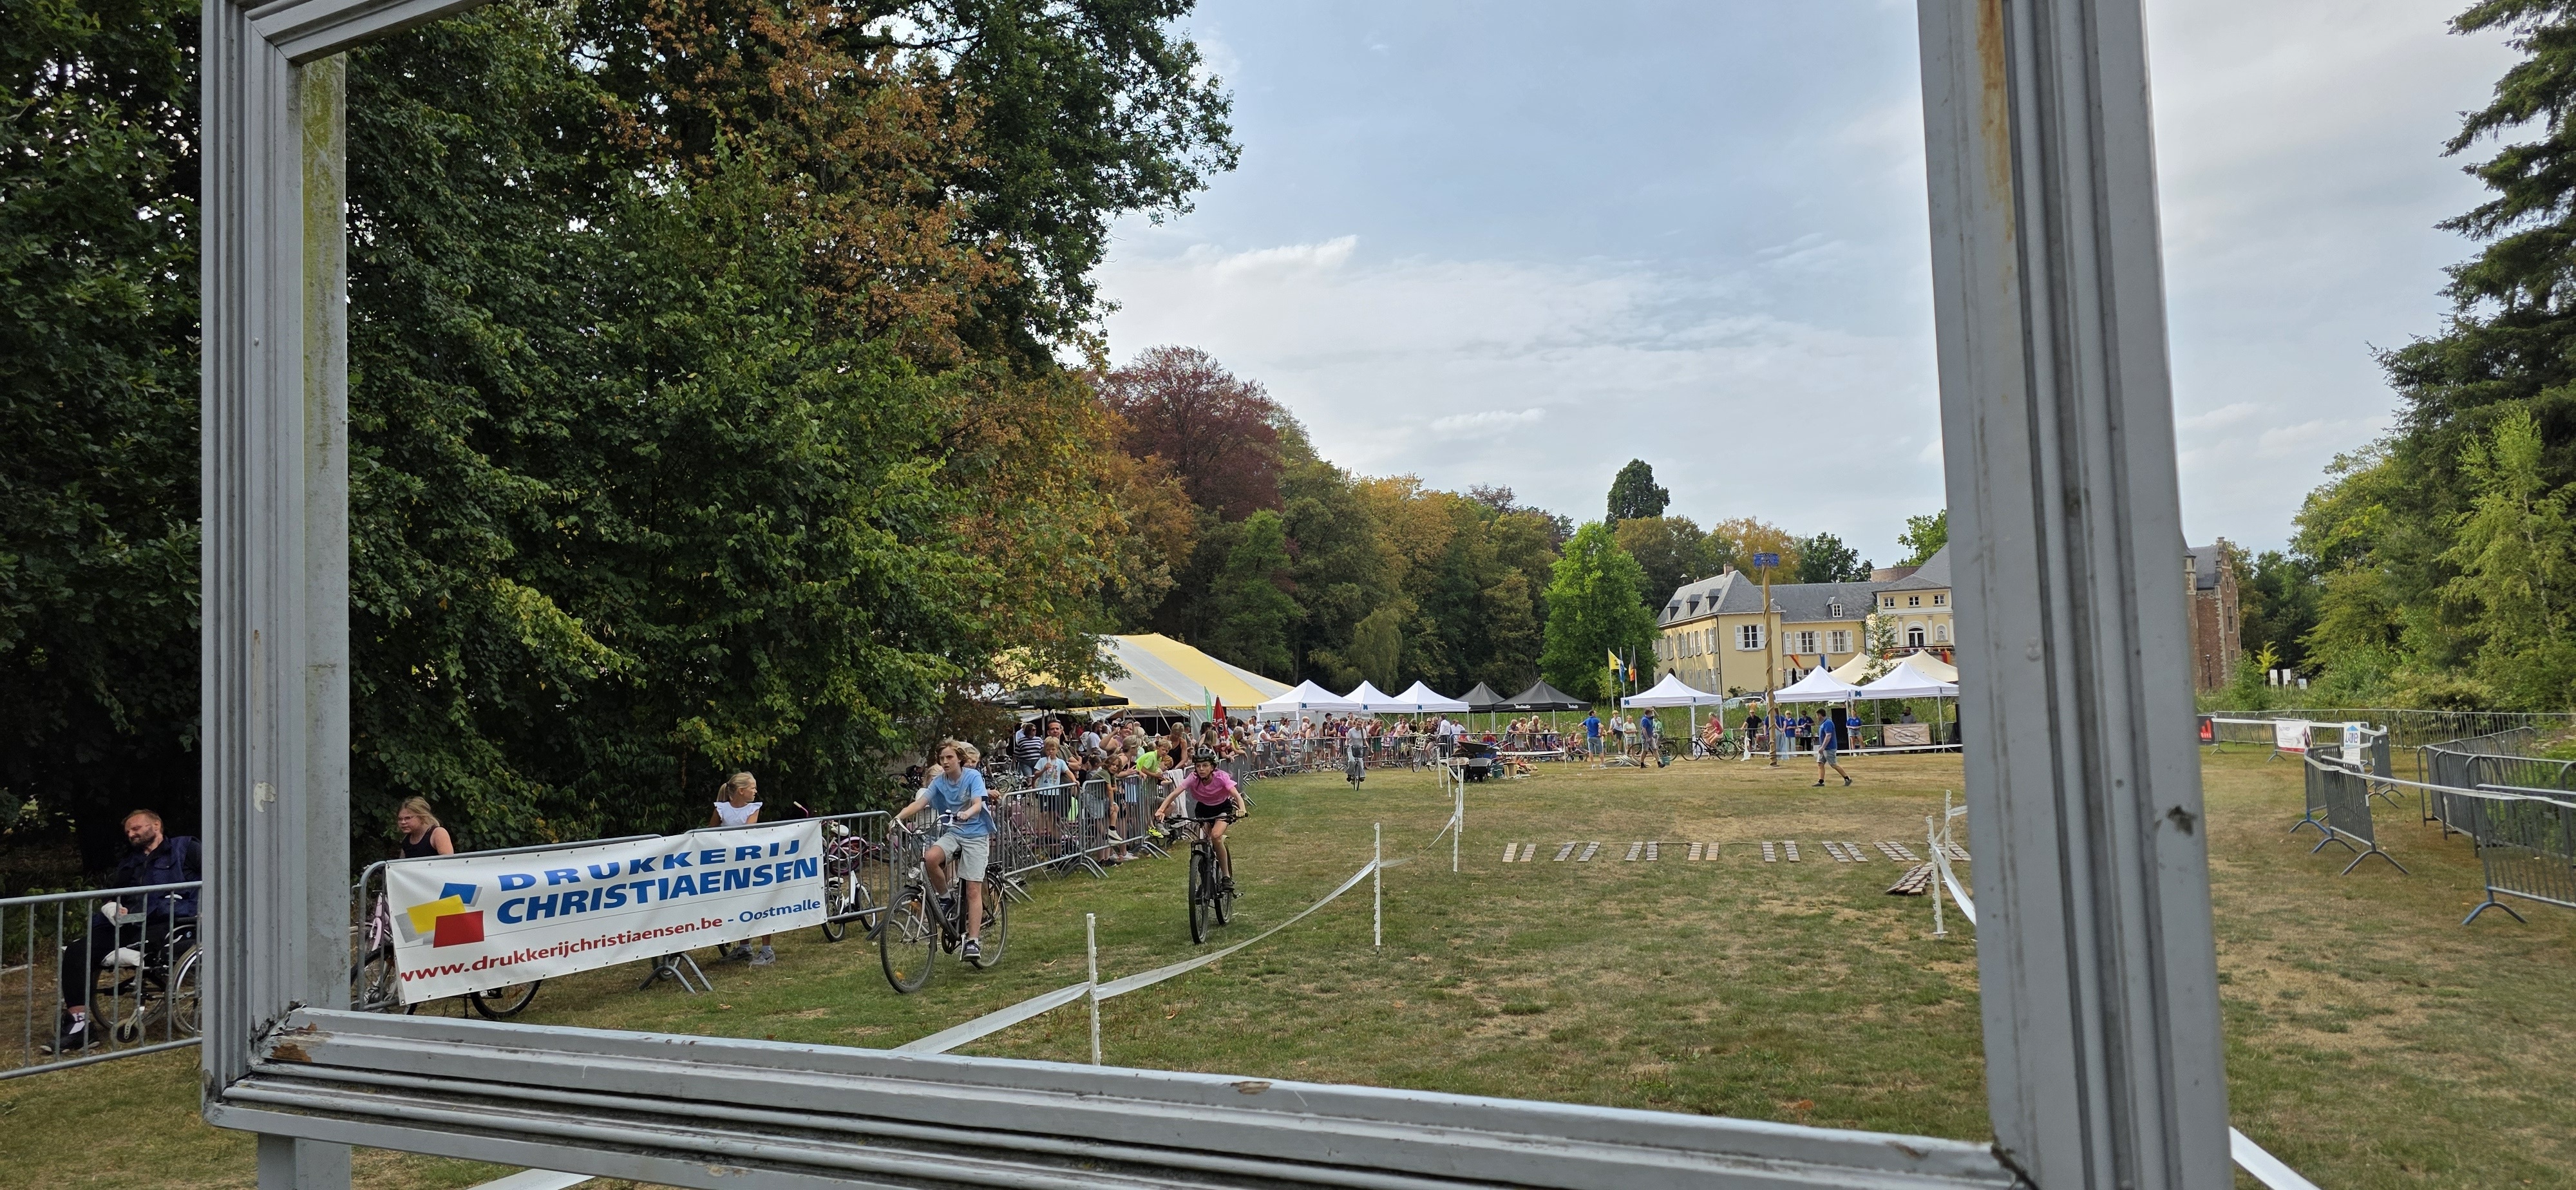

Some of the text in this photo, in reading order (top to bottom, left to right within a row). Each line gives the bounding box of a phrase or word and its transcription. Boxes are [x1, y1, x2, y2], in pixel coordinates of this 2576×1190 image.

[497, 839, 800, 892] DRUKKERIJ
[497, 856, 818, 925] CHRISTIAENSEN
[400, 917, 723, 983] www.drukkerijchristiaensen.be
[739, 899, 821, 923] Oostmalle
